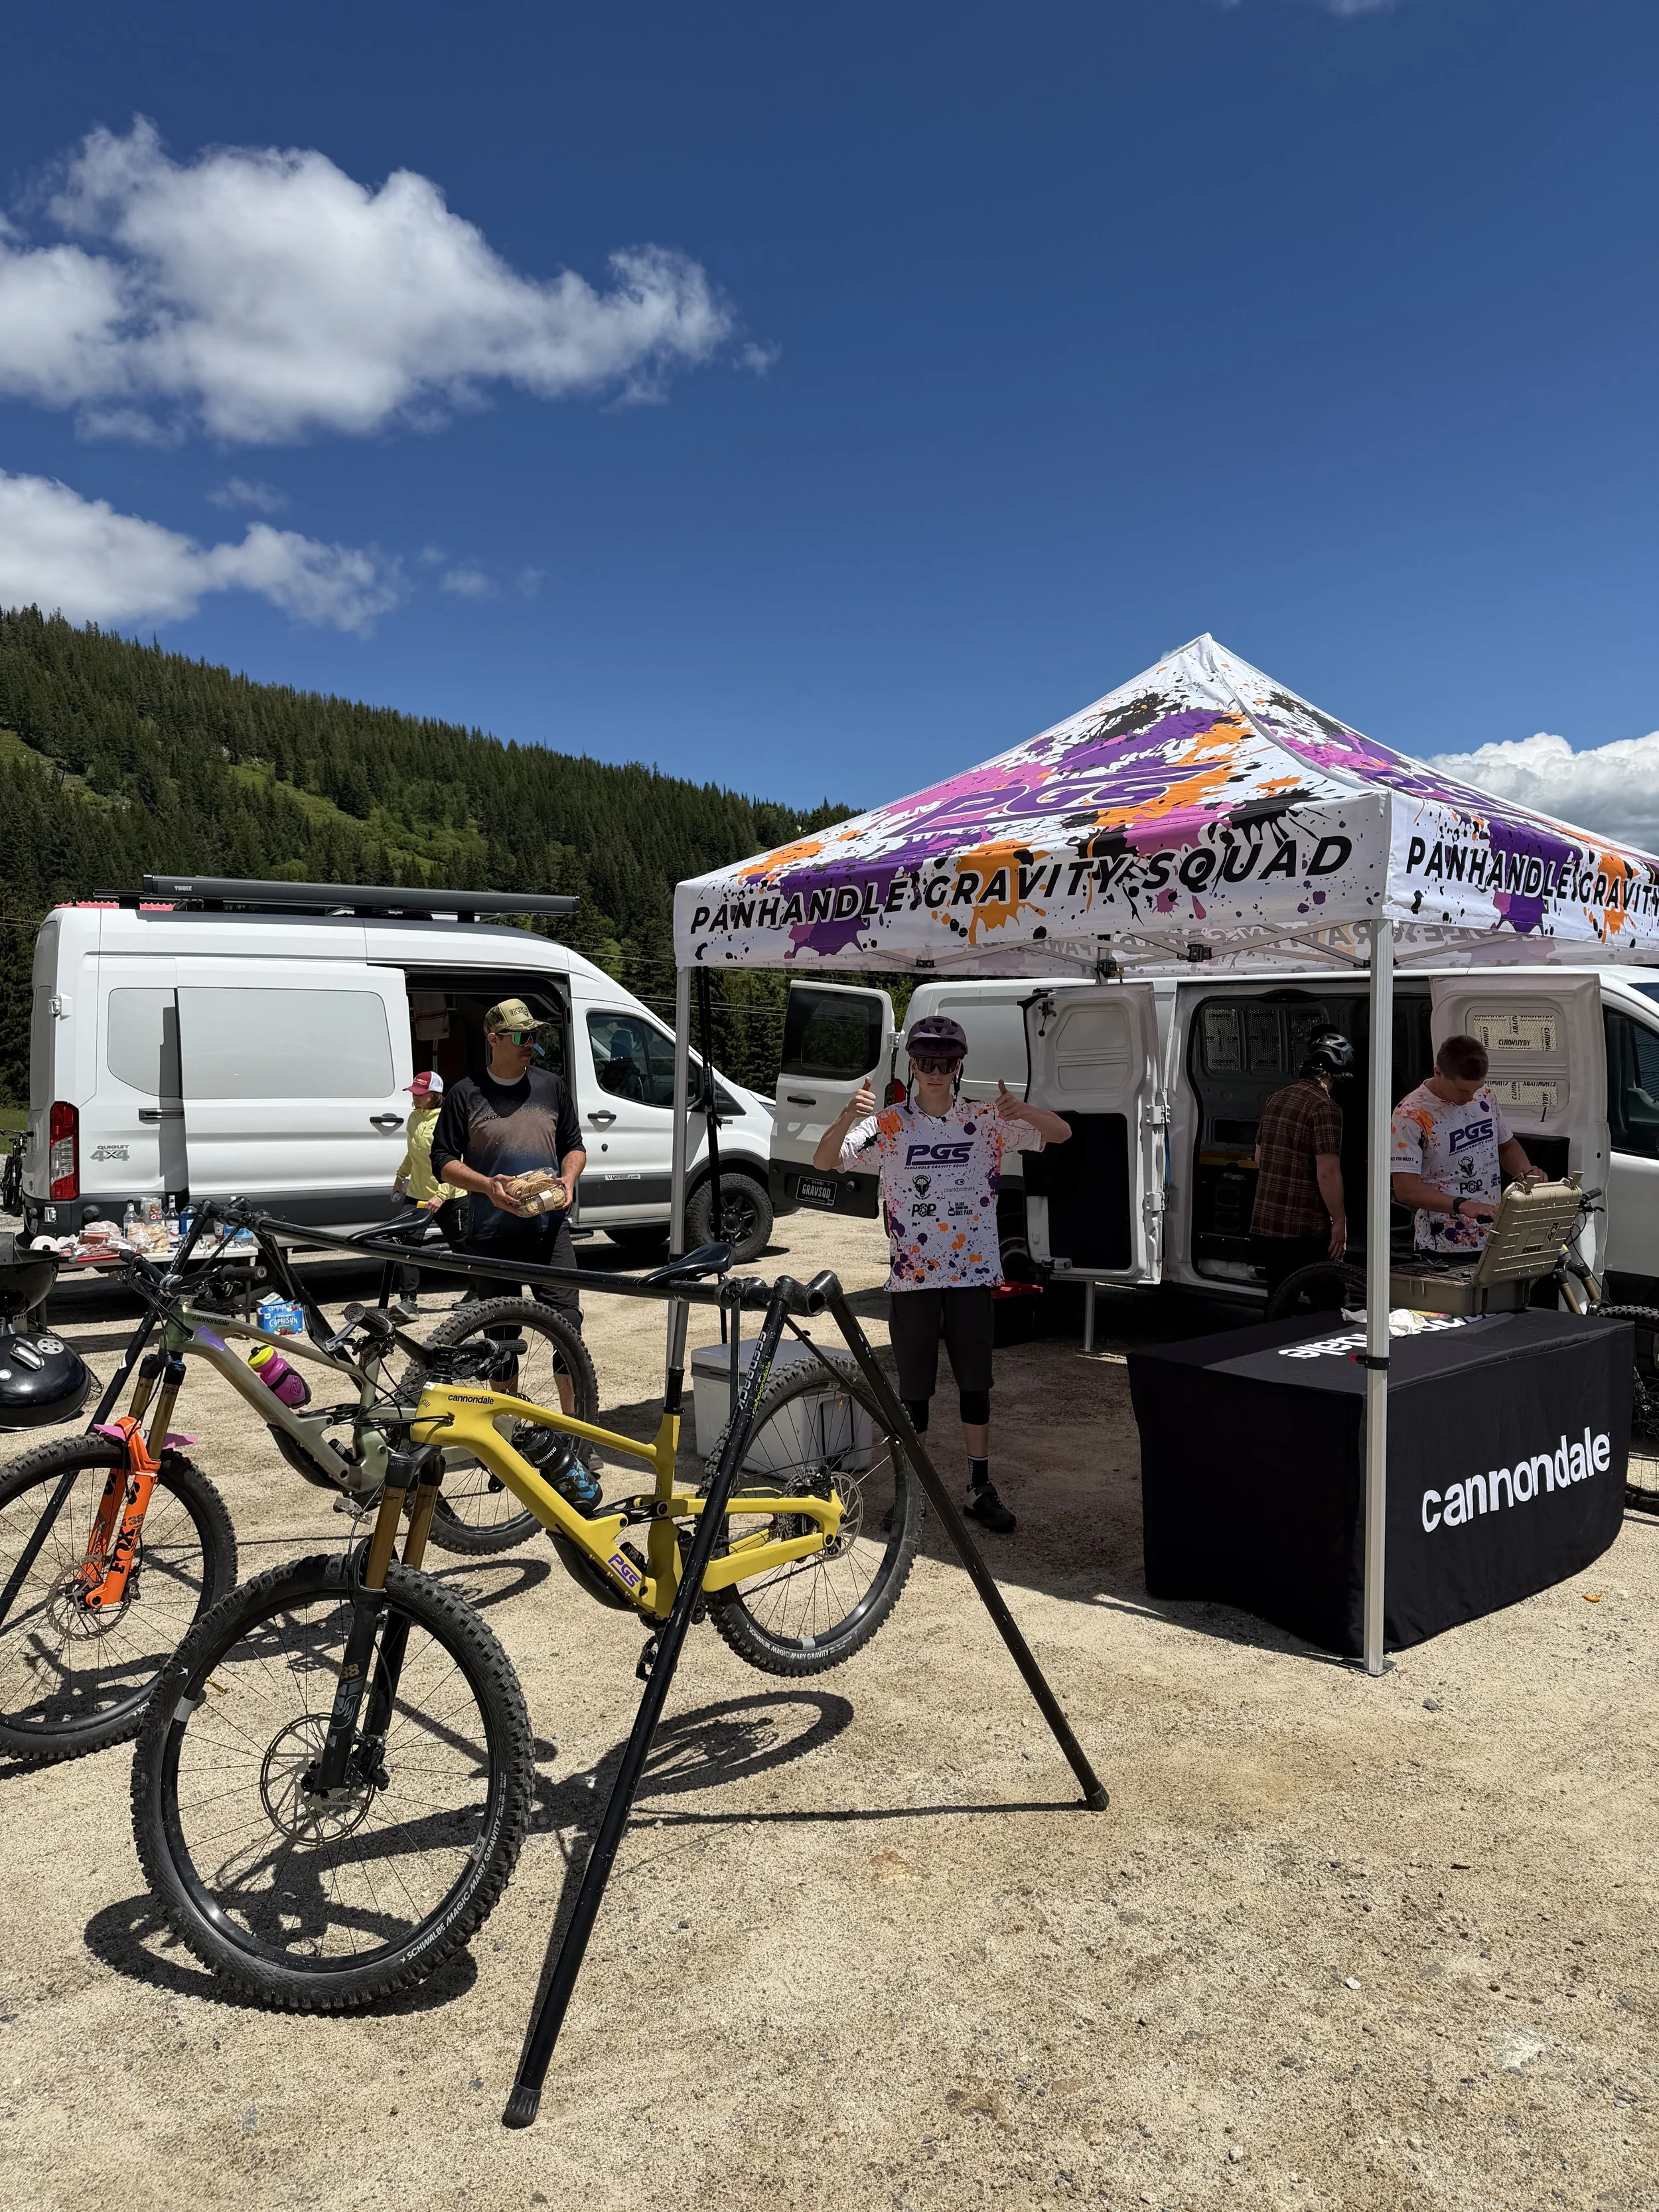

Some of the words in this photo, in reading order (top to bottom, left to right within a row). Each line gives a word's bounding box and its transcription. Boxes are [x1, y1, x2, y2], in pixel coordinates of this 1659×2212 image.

[881, 761, 1233, 839] PGS
[690, 879, 912, 934] PANHANDLE
[926, 856, 1129, 908] GRAVITY
[1141, 836, 1352, 893] SQUAD
[1406, 836, 1577, 900] PANHANDLE
[1449, 1118, 1494, 1153] PGS
[905, 1142, 975, 1166] PGS
[802, 1183, 831, 1199] GRAVSQD
[192, 1316, 230, 1327] cannondale
[448, 1394, 494, 1405] cannondale
[534, 1446, 557, 1465] SHIMANO
[1422, 1427, 1611, 1533] cannondale
[110, 1527, 137, 1574] FOX
[607, 1553, 642, 1588] PGS
[749, 1629, 771, 1650] SCHWALBE
[770, 1646, 790, 1658] MAGIC
[806, 1649, 829, 1660] GRAVITY
[407, 1922, 447, 1960] SCHWALBE
[446, 1891, 471, 1928] MAGIC
[470, 1860, 486, 1894] MARY
[484, 1816, 502, 1862] GRAVITY
